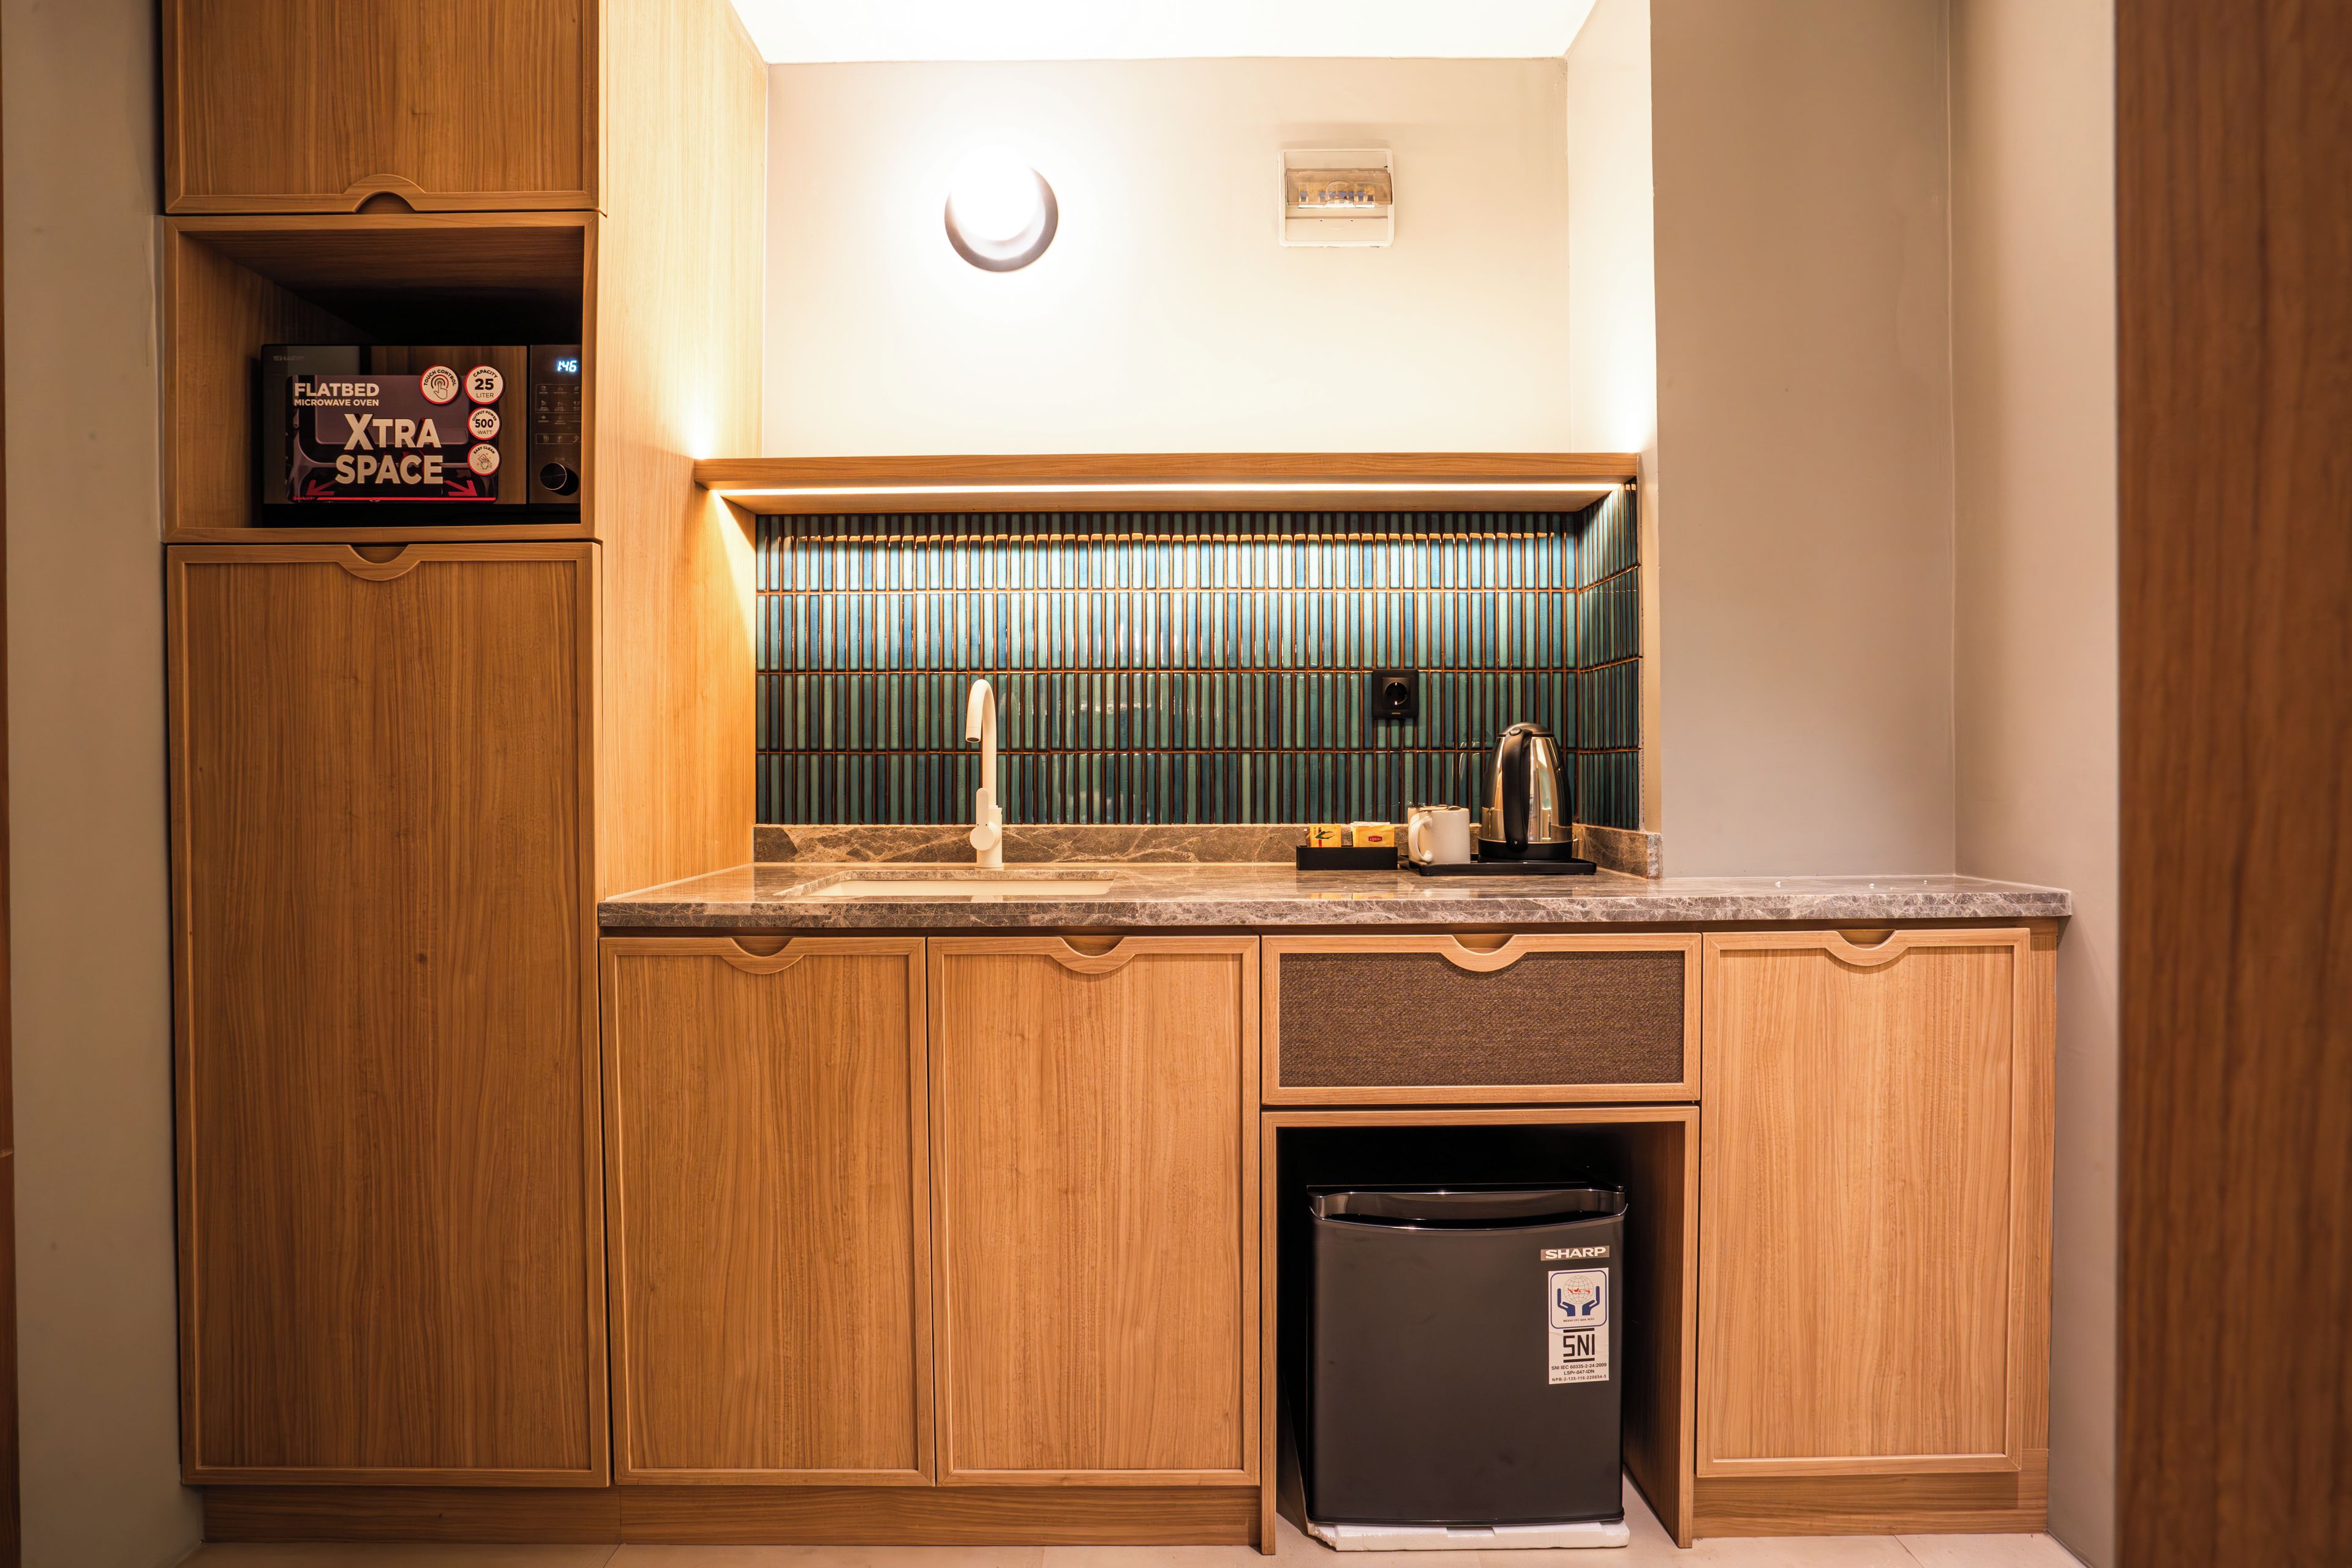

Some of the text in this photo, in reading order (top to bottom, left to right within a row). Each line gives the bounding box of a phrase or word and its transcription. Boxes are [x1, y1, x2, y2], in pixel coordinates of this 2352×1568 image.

[423, 369, 456, 386] TOUCH CONTROL
[473, 369, 498, 379] CAPACITY
[294, 383, 380, 397] FLATBED
[475, 379, 494, 391] 25
[472, 410, 497, 421] OUTPUT POWER
[475, 419, 494, 428] 500
[344, 413, 442, 451] XTRA
[483, 446, 495, 454] CLEAN
[335, 454, 443, 484] SPACE
[1545, 1246, 1606, 1259] SHARP
[1563, 1334, 1595, 1357] SNI
